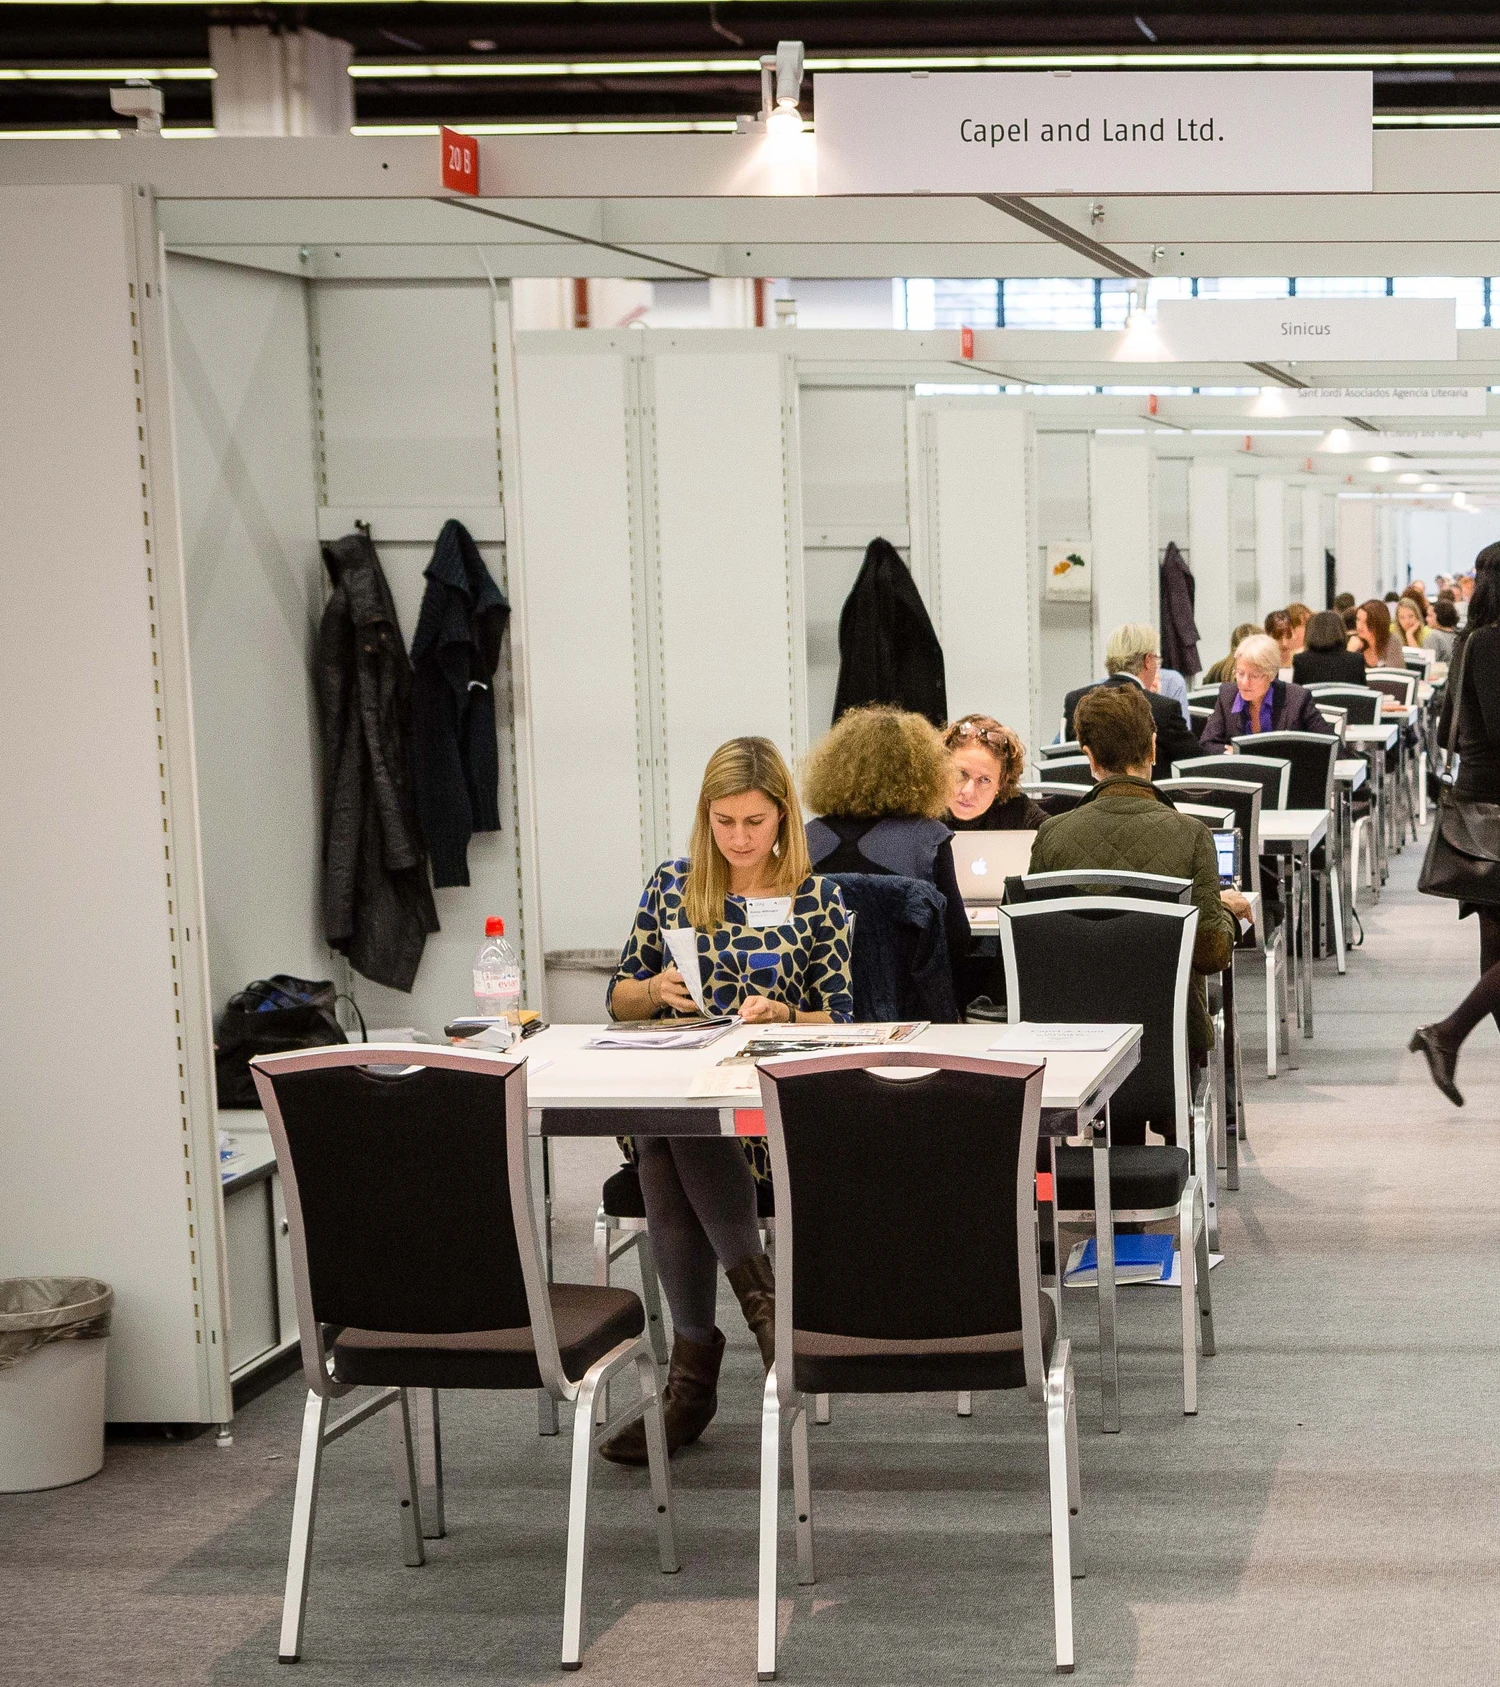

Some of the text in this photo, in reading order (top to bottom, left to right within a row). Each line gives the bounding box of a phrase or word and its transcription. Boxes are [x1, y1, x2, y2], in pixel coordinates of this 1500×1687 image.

[960, 117, 1226, 148] Capel and Land Ltd.
[449, 144, 472, 174] 20 B
[1281, 321, 1331, 336] Sinicus
